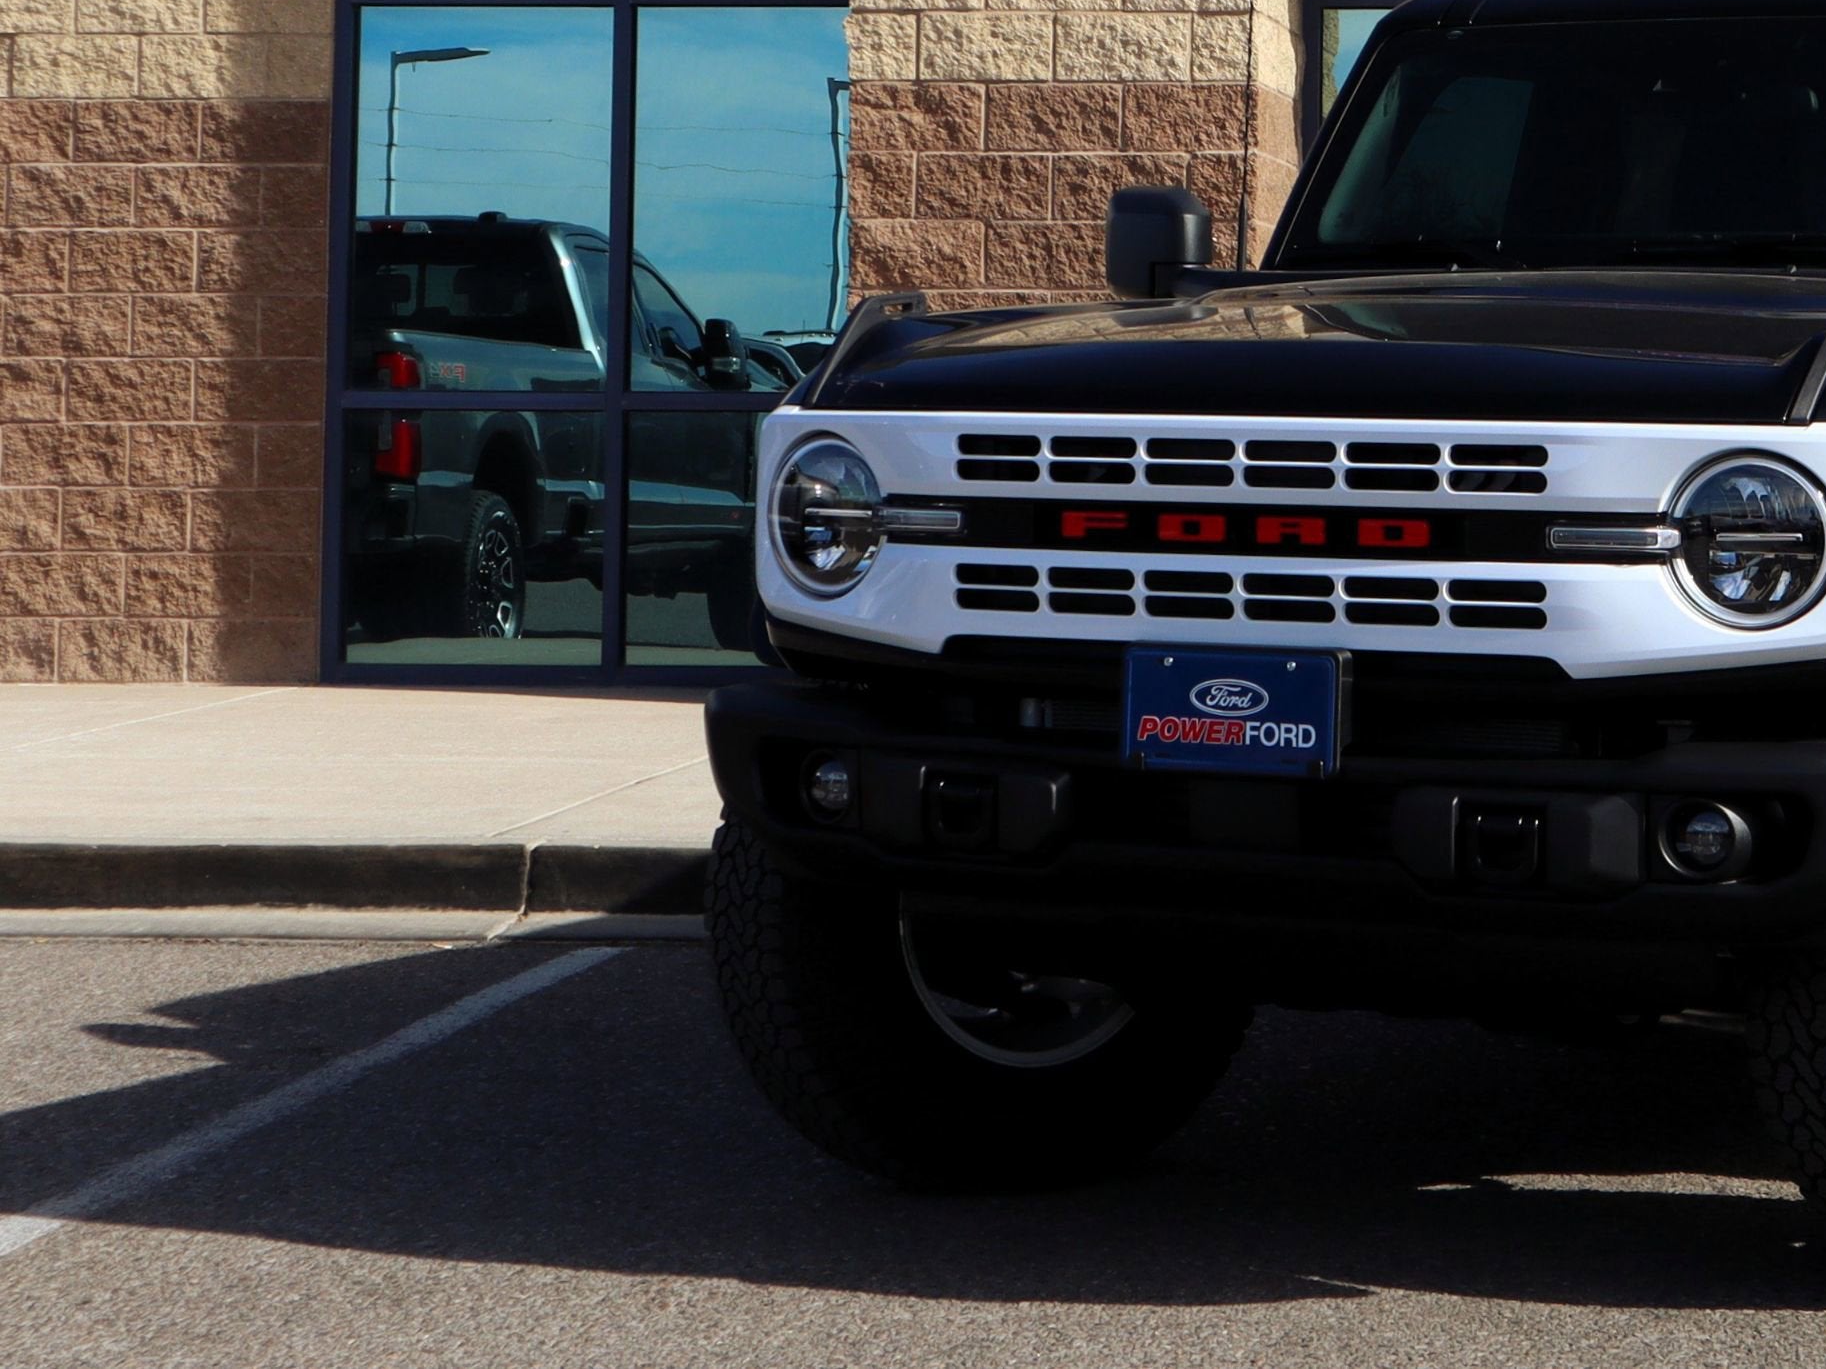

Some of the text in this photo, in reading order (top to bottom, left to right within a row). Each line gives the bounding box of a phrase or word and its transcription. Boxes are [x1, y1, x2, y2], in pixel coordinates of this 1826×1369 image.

[1060, 510, 1431, 548] FORD
[1205, 685, 1252, 709] Ford
[1137, 715, 1317, 749] POWERFORD
